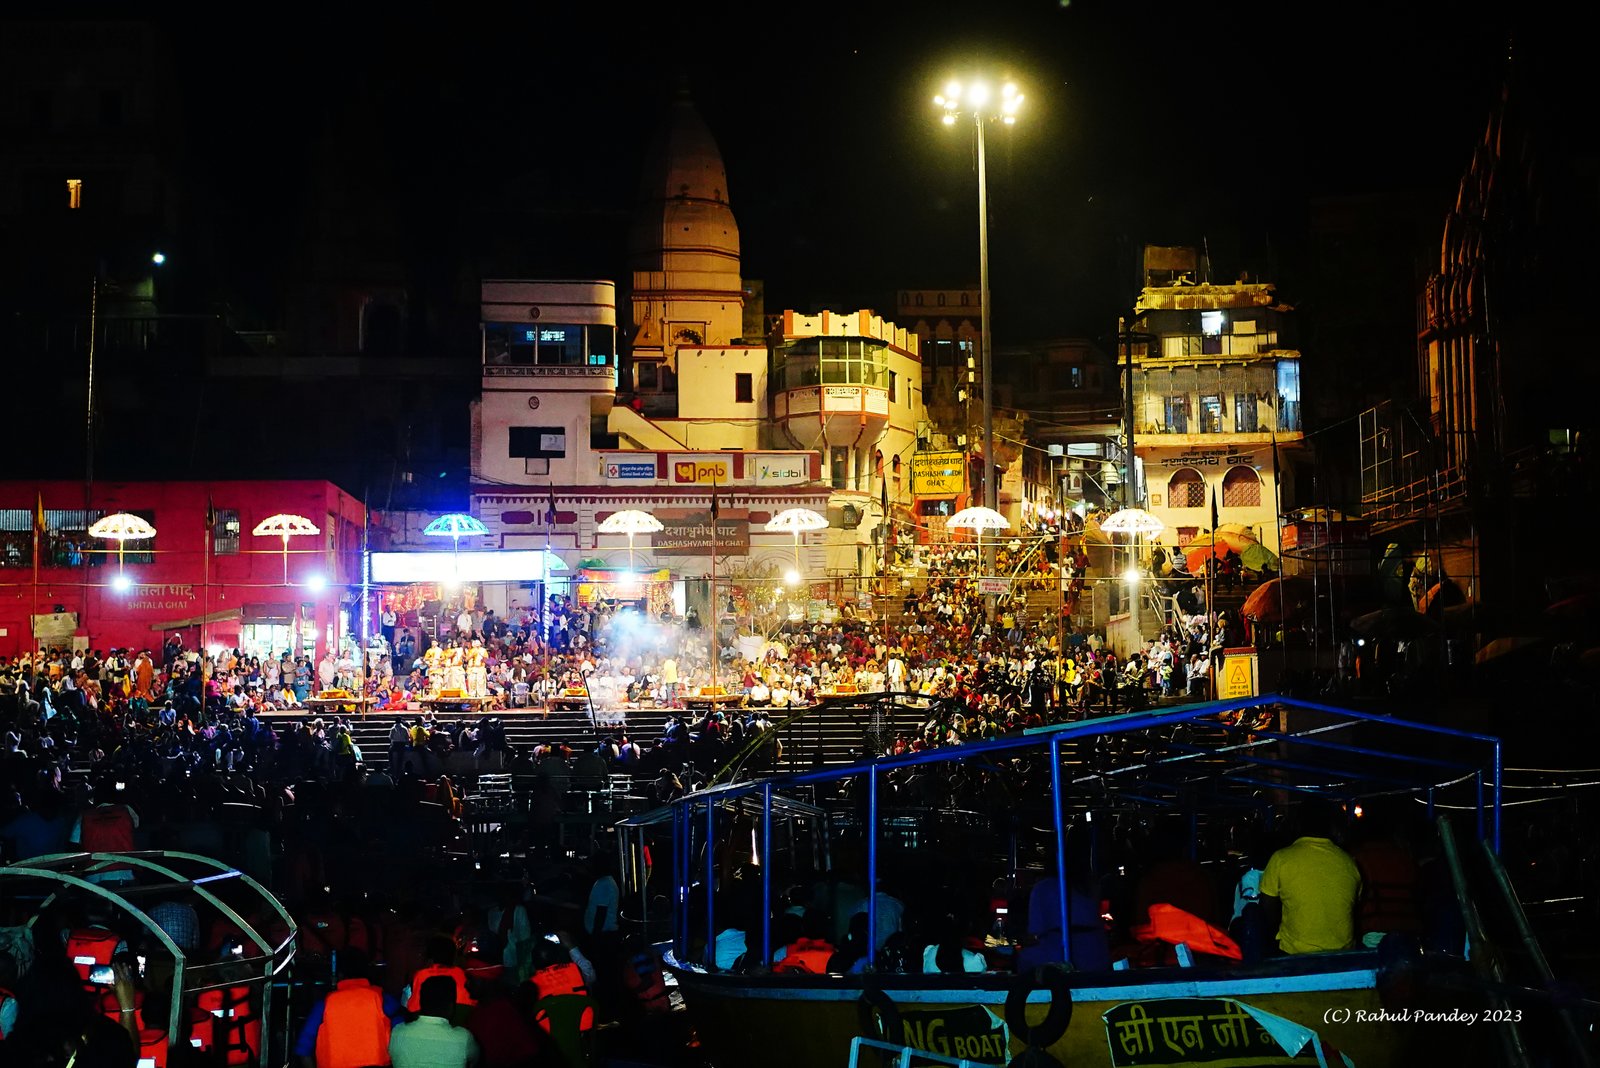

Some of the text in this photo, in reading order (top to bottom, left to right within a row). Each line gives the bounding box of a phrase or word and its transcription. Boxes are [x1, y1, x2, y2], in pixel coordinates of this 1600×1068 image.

[698, 464, 725, 481] pnb
[772, 469, 801, 478] sidbi
[717, 526, 737, 537] घाट
[128, 601, 188, 610] SHITALA GHAT
[1115, 1004, 1154, 1056] सी
[1157, 1015, 1205, 1057] एन
[954, 1034, 1005, 1060] BOAT
